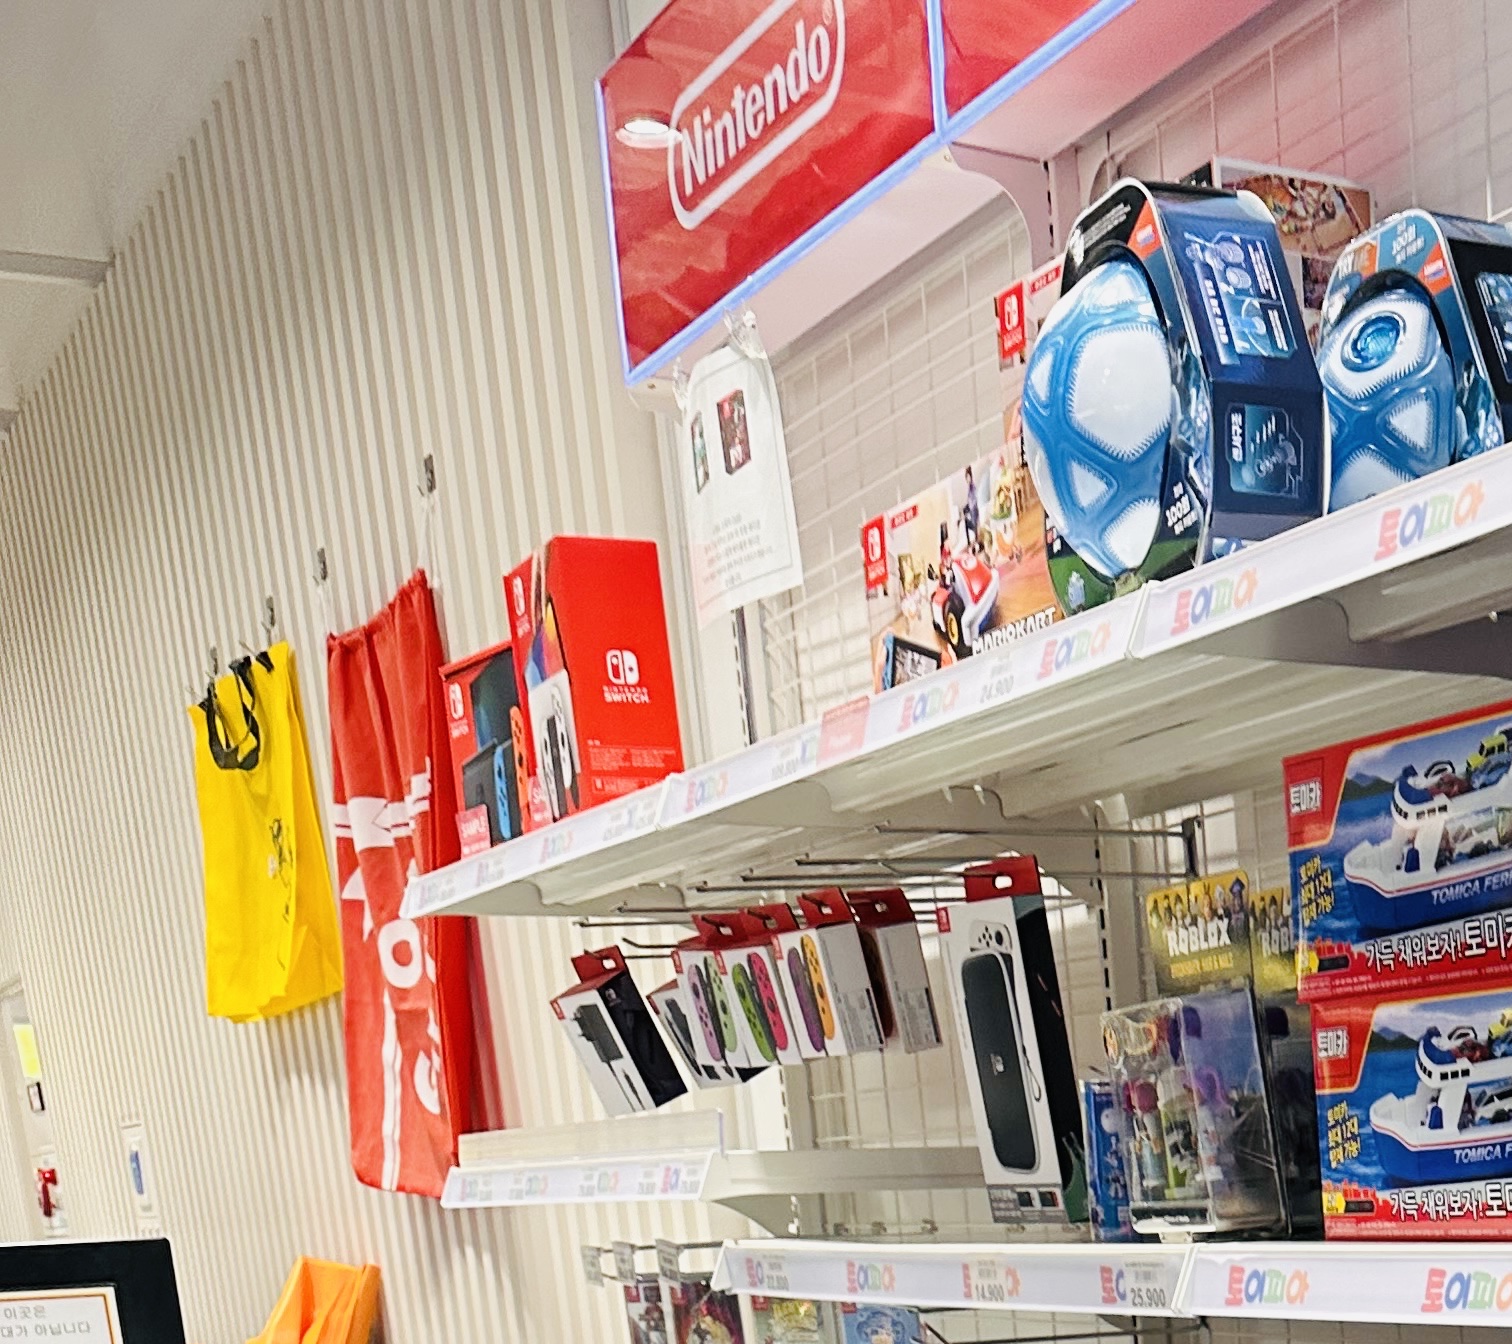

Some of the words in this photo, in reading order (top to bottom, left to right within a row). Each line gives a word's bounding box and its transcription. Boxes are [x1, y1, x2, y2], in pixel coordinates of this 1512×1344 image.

[680, 19, 830, 198] Nintendo
[1373, 480, 1486, 562] 토이피아
[1169, 566, 1259, 637] 토이피아
[604, 693, 650, 705] SWITCH
[1289, 777, 1322, 815] 토미카
[1431, 882, 1480, 906] TOMICA
[1167, 916, 1232, 958] ROBLOX
[1366, 942, 1394, 972] 가득
[1397, 933, 1463, 970] 채워보자!
[1316, 1027, 1348, 1059] 토미카
[1454, 1143, 1500, 1165] TOMICA
[1391, 1191, 1418, 1221] 가득
[1421, 1187, 1484, 1219] 채워보자!
[1225, 1265, 1310, 1306] 토이피아
[34, 1320, 92, 1338] 아닙니다
